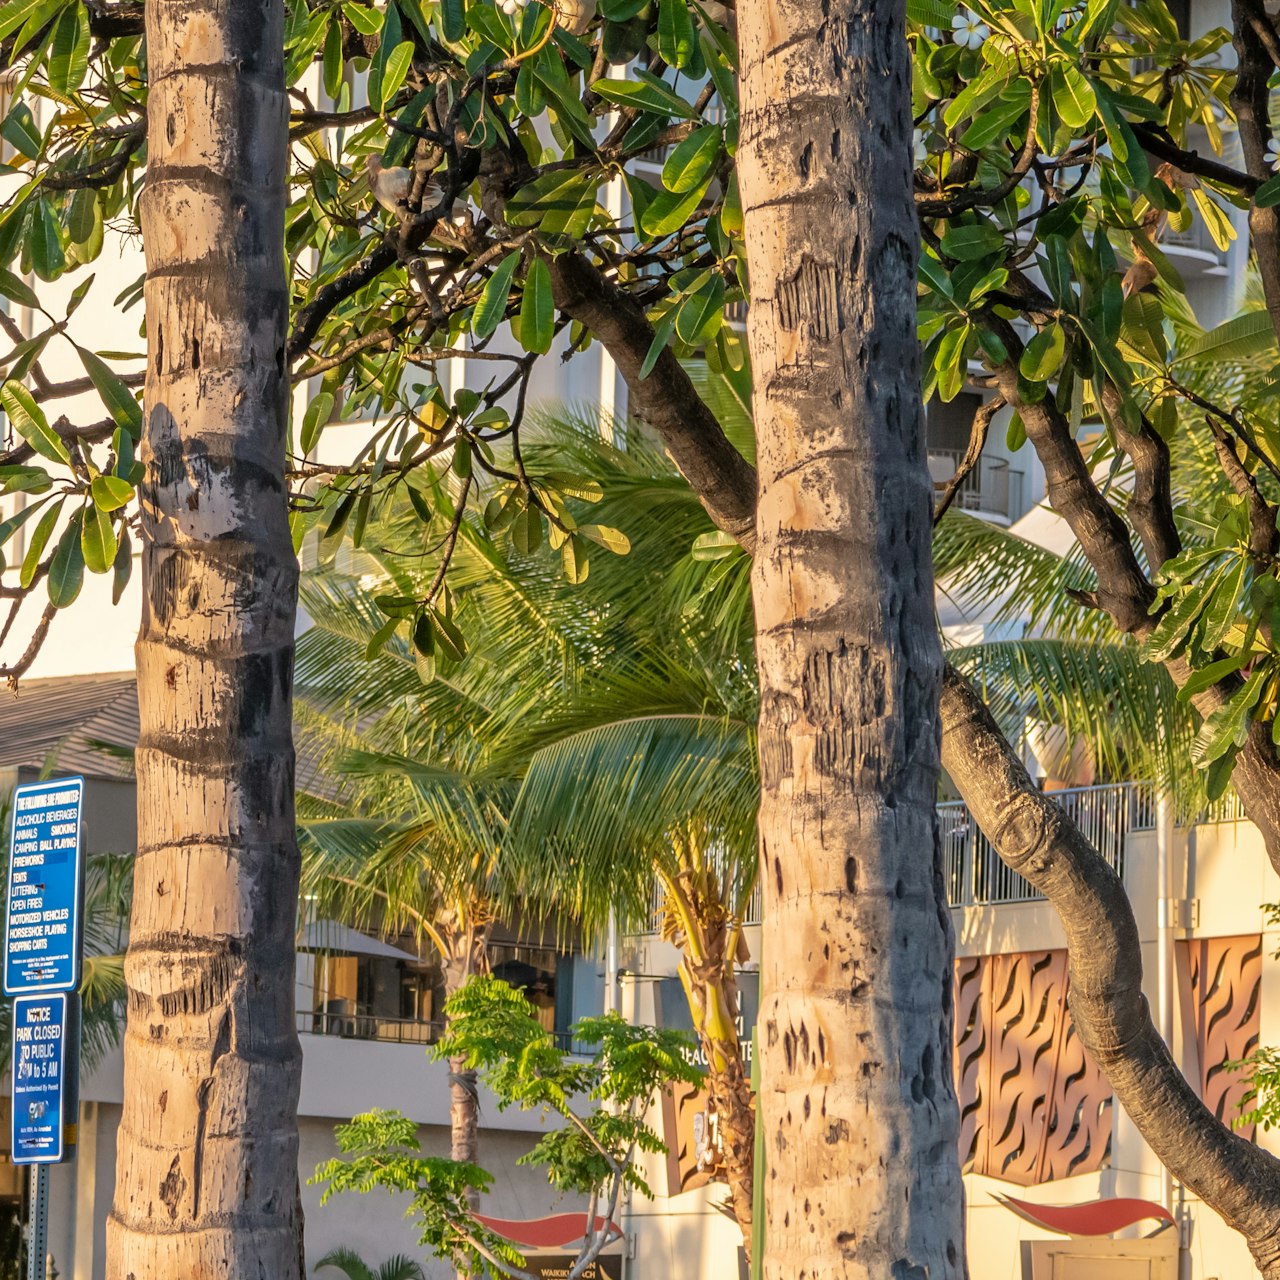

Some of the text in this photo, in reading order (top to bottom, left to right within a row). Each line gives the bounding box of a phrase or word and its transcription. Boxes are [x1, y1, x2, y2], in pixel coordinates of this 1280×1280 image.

[17, 809, 78, 827] ALCOHOLIC BEVERAGES
[16, 823, 76, 840] ANIMALS SMOKING
[15, 838, 76, 854] CAMPING BALL PLAYING
[14, 854, 44, 868] FIREWORKS
[13, 872, 27, 883] TENTS
[12, 885, 38, 897] LITTERING
[12, 898, 43, 911] OPEN FIRES
[11, 909, 69, 925] MOTORIZED VEHICLES
[10, 924, 67, 939] HORSESHOE PLAYING
[10, 939, 48, 953] SHOPPING CARTS
[27, 1007, 51, 1023] NOTICE
[17, 1025, 61, 1042] PARK CLOSED
[22, 1044, 55, 1060] TO PUBLIC
[34, 1064, 40, 1079] to
[41, 1061, 47, 1078] 5
[48, 1062, 58, 1077] AM
